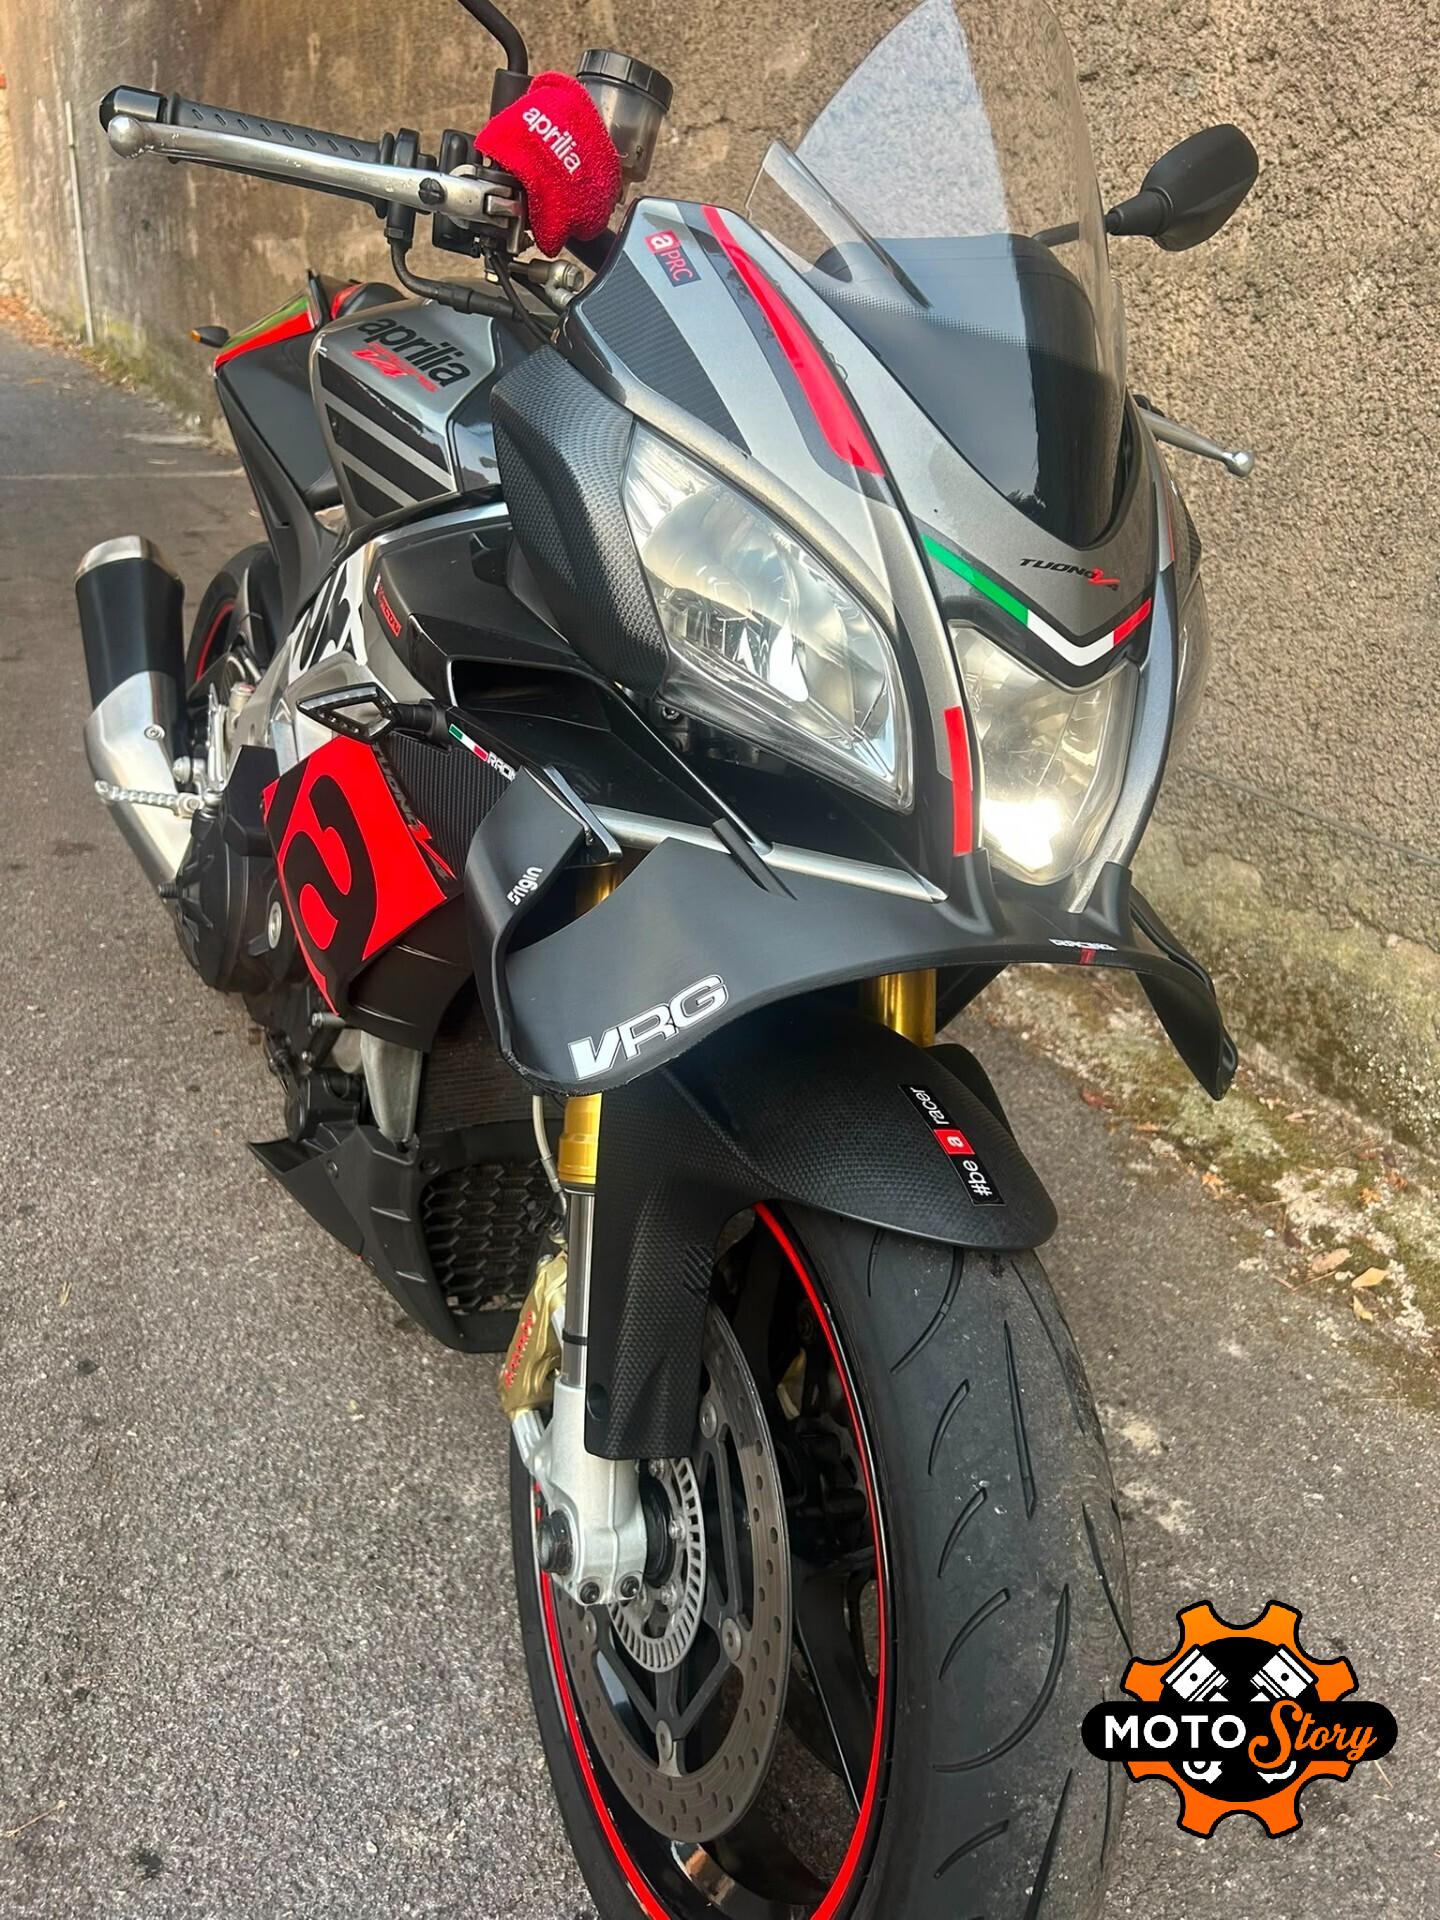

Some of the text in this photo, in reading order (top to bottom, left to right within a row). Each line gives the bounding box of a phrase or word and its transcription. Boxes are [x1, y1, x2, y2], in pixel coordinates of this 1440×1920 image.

[522, 107, 581, 175] aprilia
[357, 318, 471, 388] aprilia
[567, 974, 729, 1081] VRG
[909, 1086, 993, 1197] #be a racer
